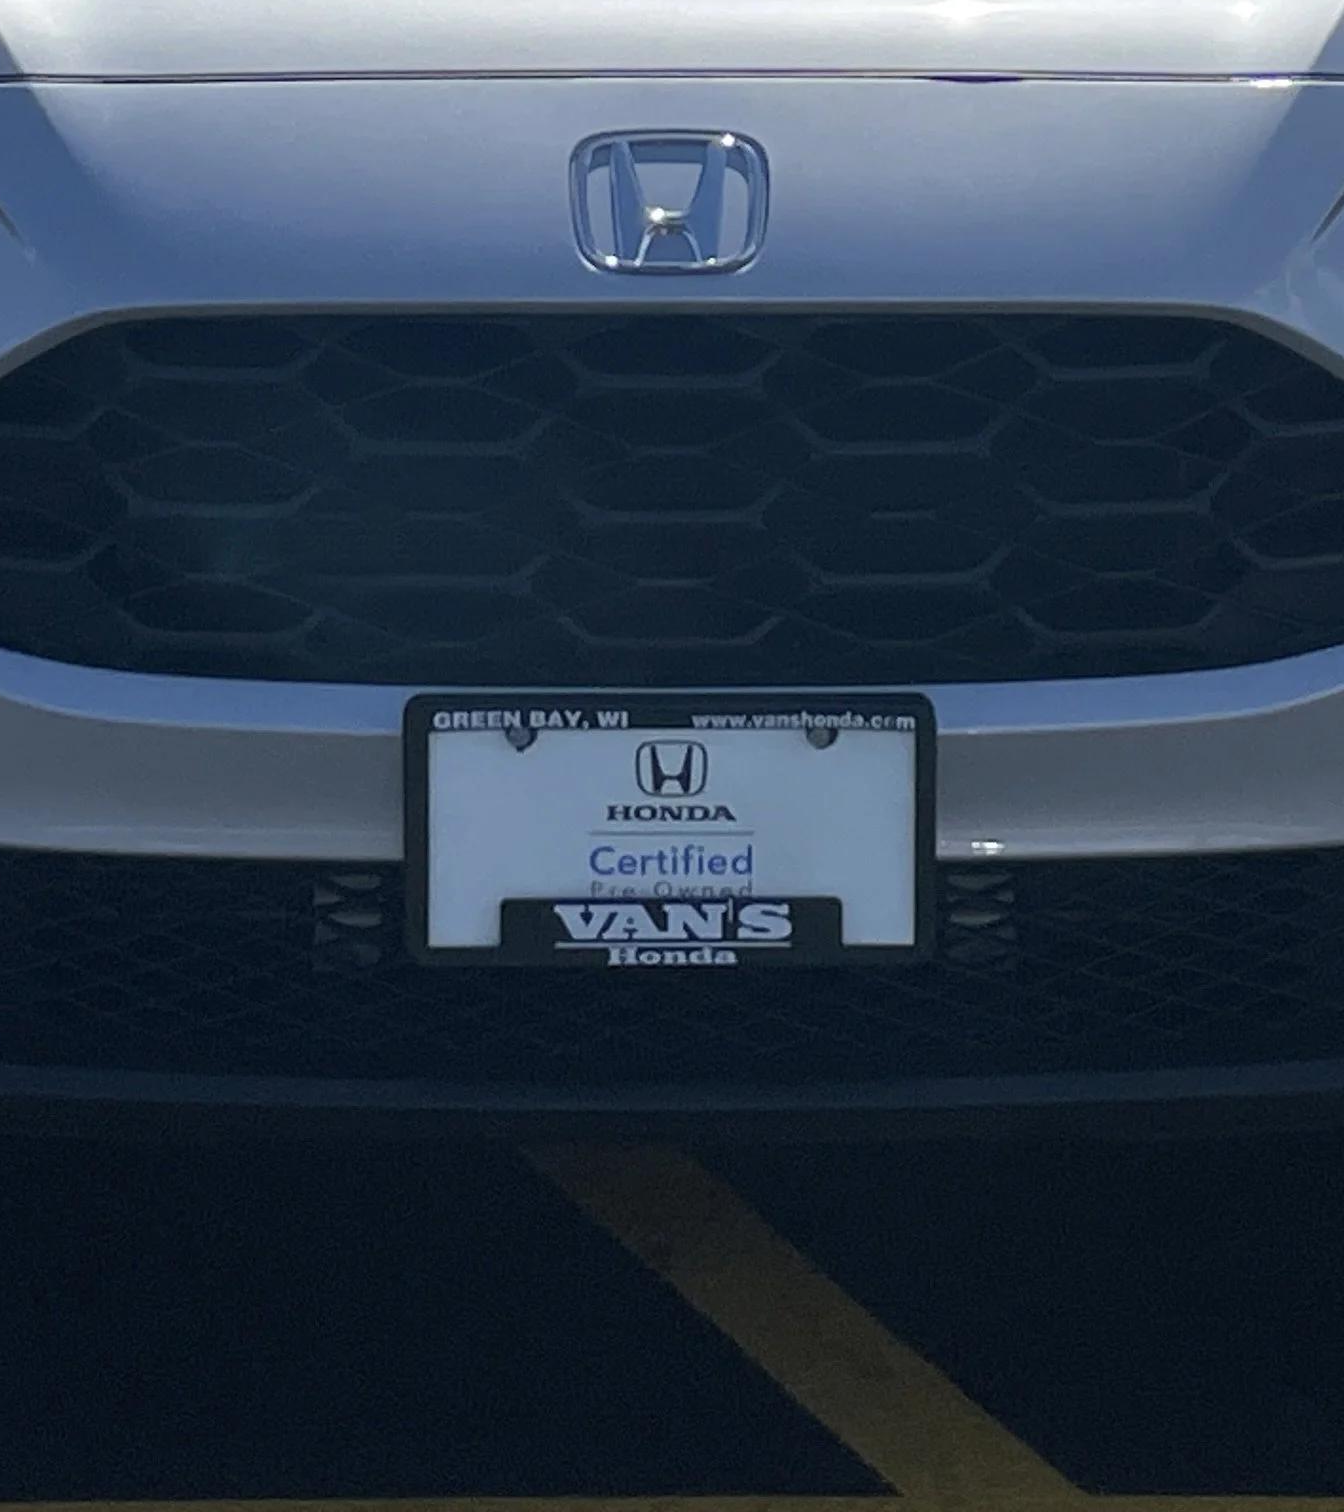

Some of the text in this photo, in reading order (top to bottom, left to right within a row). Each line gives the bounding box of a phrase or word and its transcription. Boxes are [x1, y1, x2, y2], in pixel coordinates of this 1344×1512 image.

[433, 710, 629, 730] GREEN BAY, WI
[607, 804, 737, 822] HONDA
[589, 843, 753, 876] Certified
[553, 897, 793, 940] VAN'S
[608, 946, 738, 966] Honda
